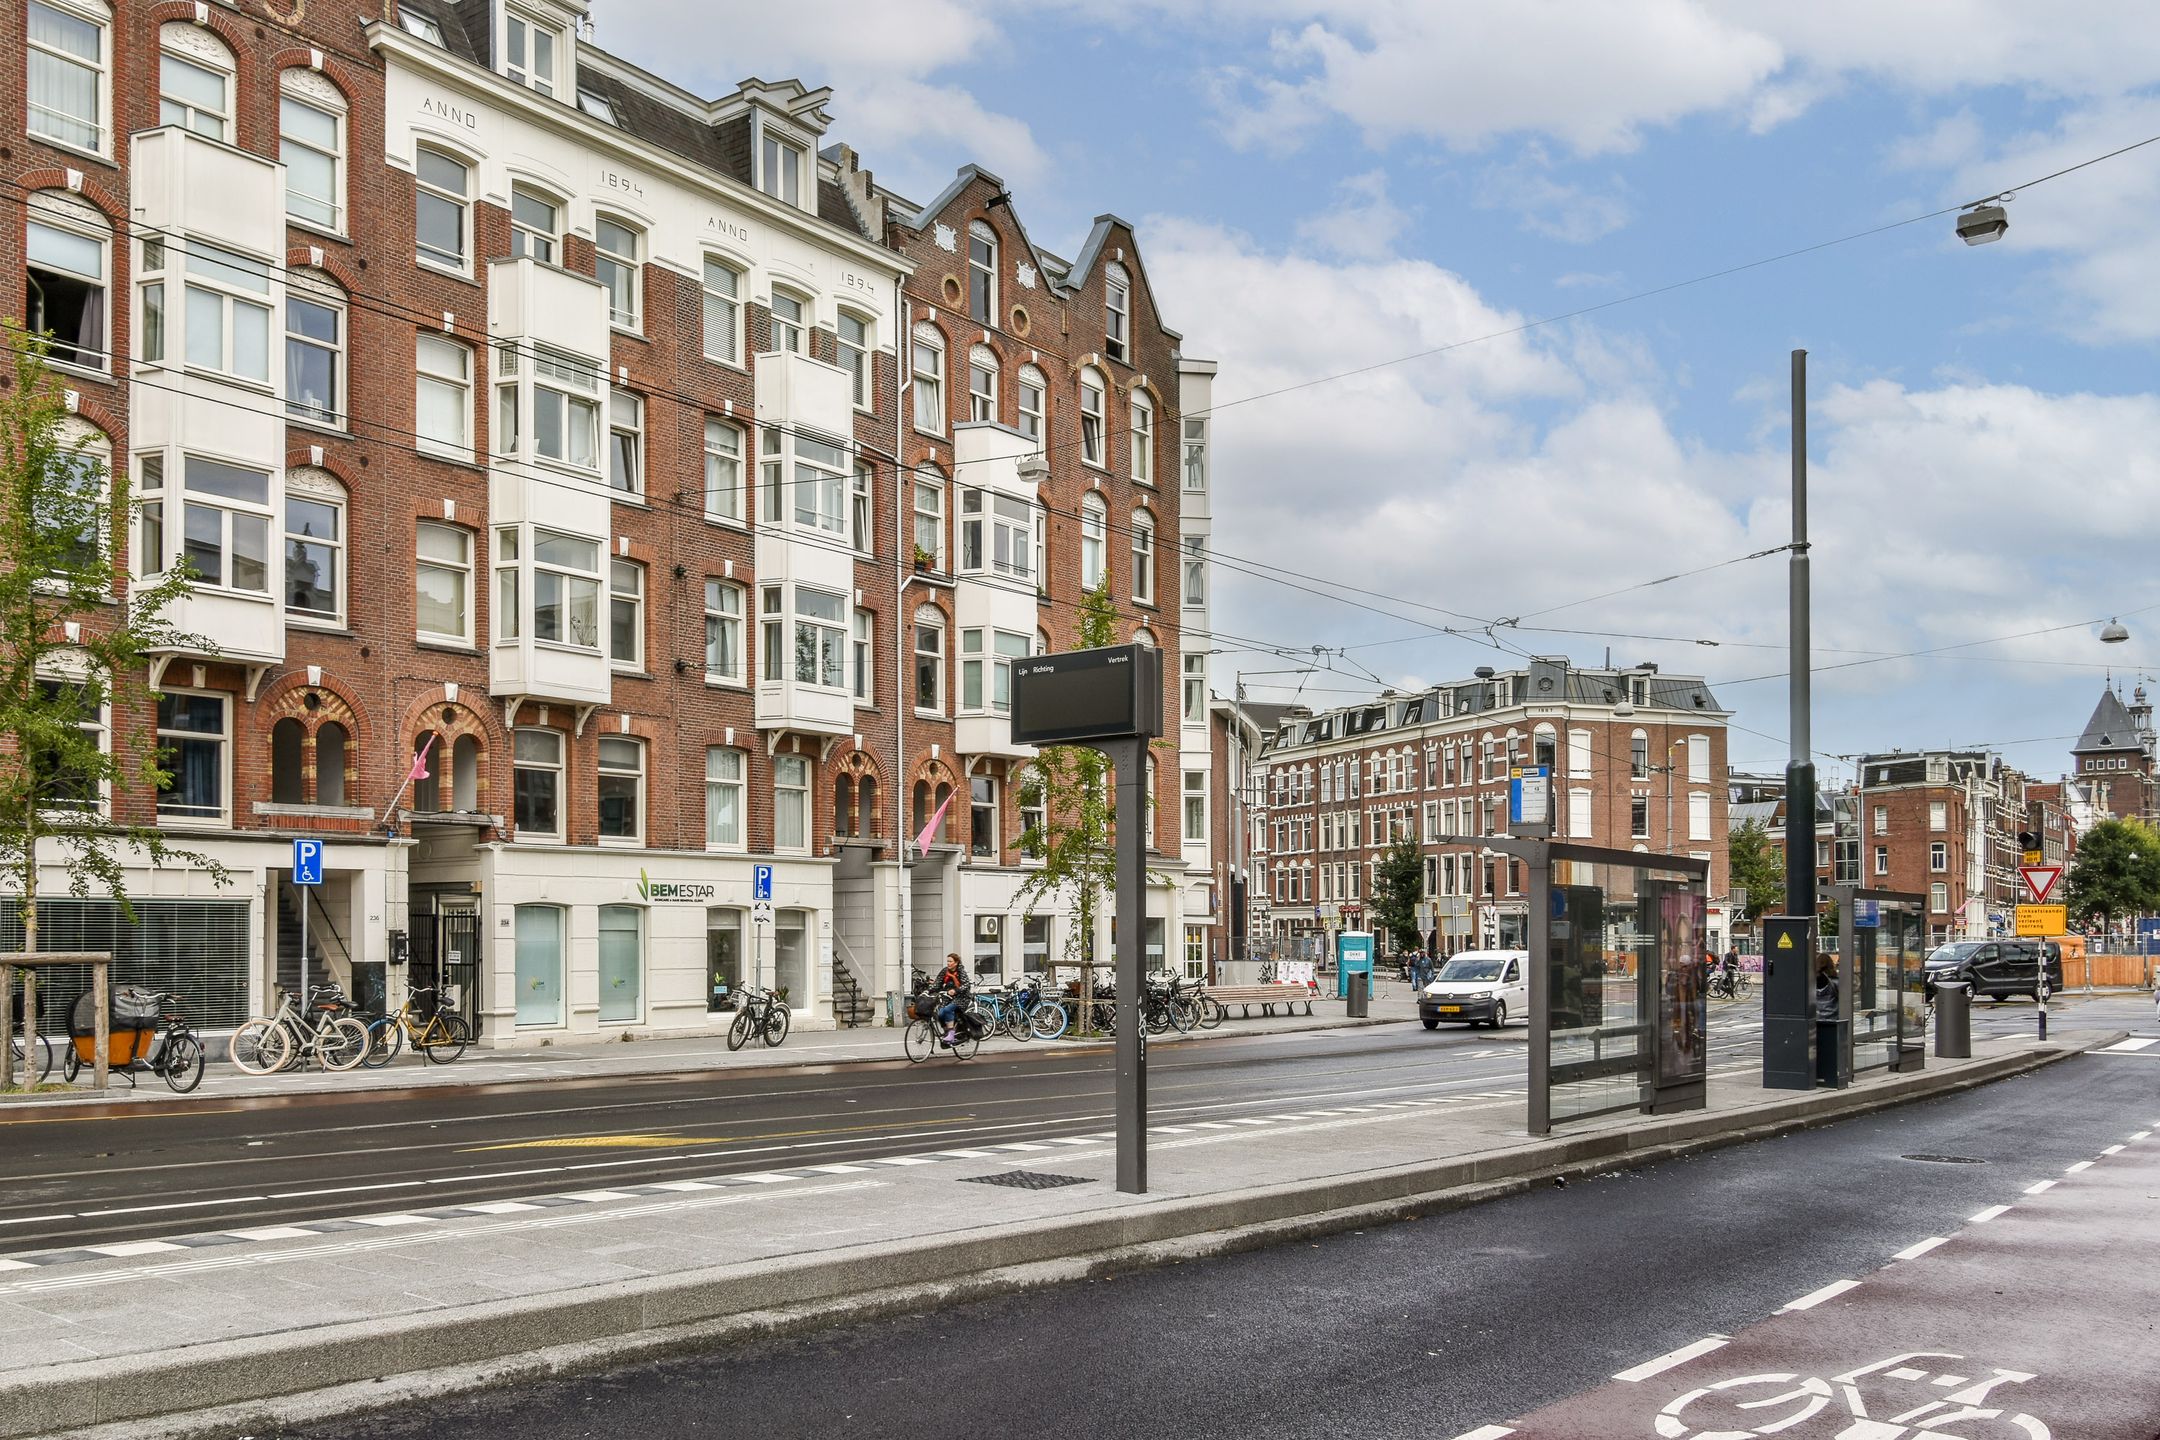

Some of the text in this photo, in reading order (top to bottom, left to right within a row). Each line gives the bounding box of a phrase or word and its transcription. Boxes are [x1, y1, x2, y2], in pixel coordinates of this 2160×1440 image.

[423, 96, 477, 130] ANNO
[601, 170, 644, 198] 1894
[708, 215, 748, 242] ANNO
[841, 271, 875, 294] 1894
[1018, 664, 1054, 676] Lijn Richting
[1107, 654, 1129, 664] Vertrek
[301, 842, 316, 865] P
[758, 867, 768, 884] P
[650, 883, 715, 897] BEMESTAR
